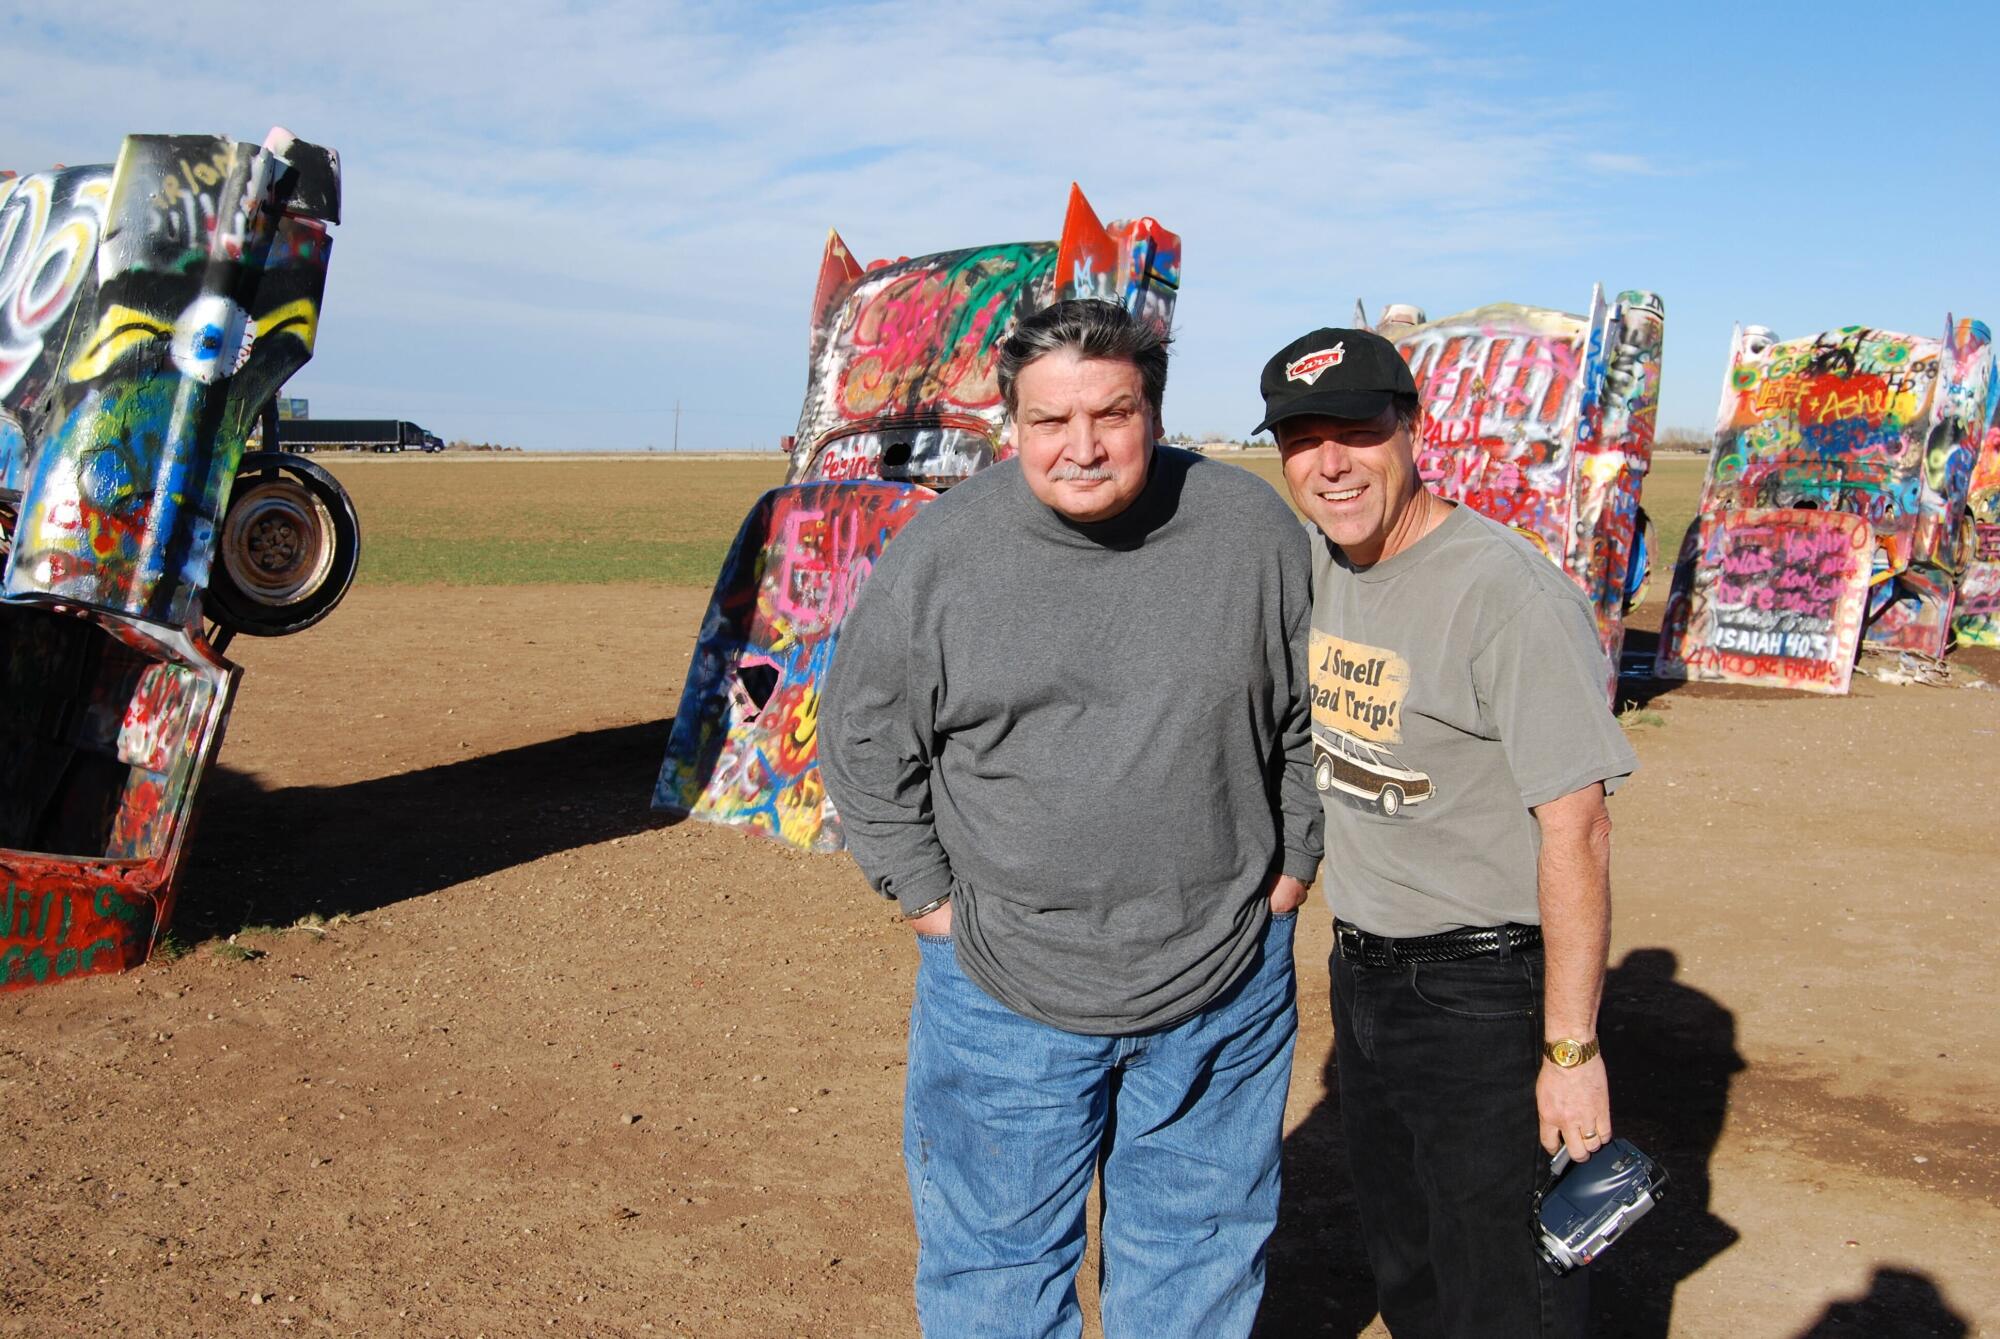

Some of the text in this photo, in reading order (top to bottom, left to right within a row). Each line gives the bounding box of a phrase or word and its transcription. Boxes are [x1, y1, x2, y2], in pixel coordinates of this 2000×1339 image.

[1291, 354, 1336, 376] Cars
[1715, 627, 1783, 655] ISAIAH
[1319, 645, 1332, 672] I
[1310, 684, 1397, 731] oad Trip!
